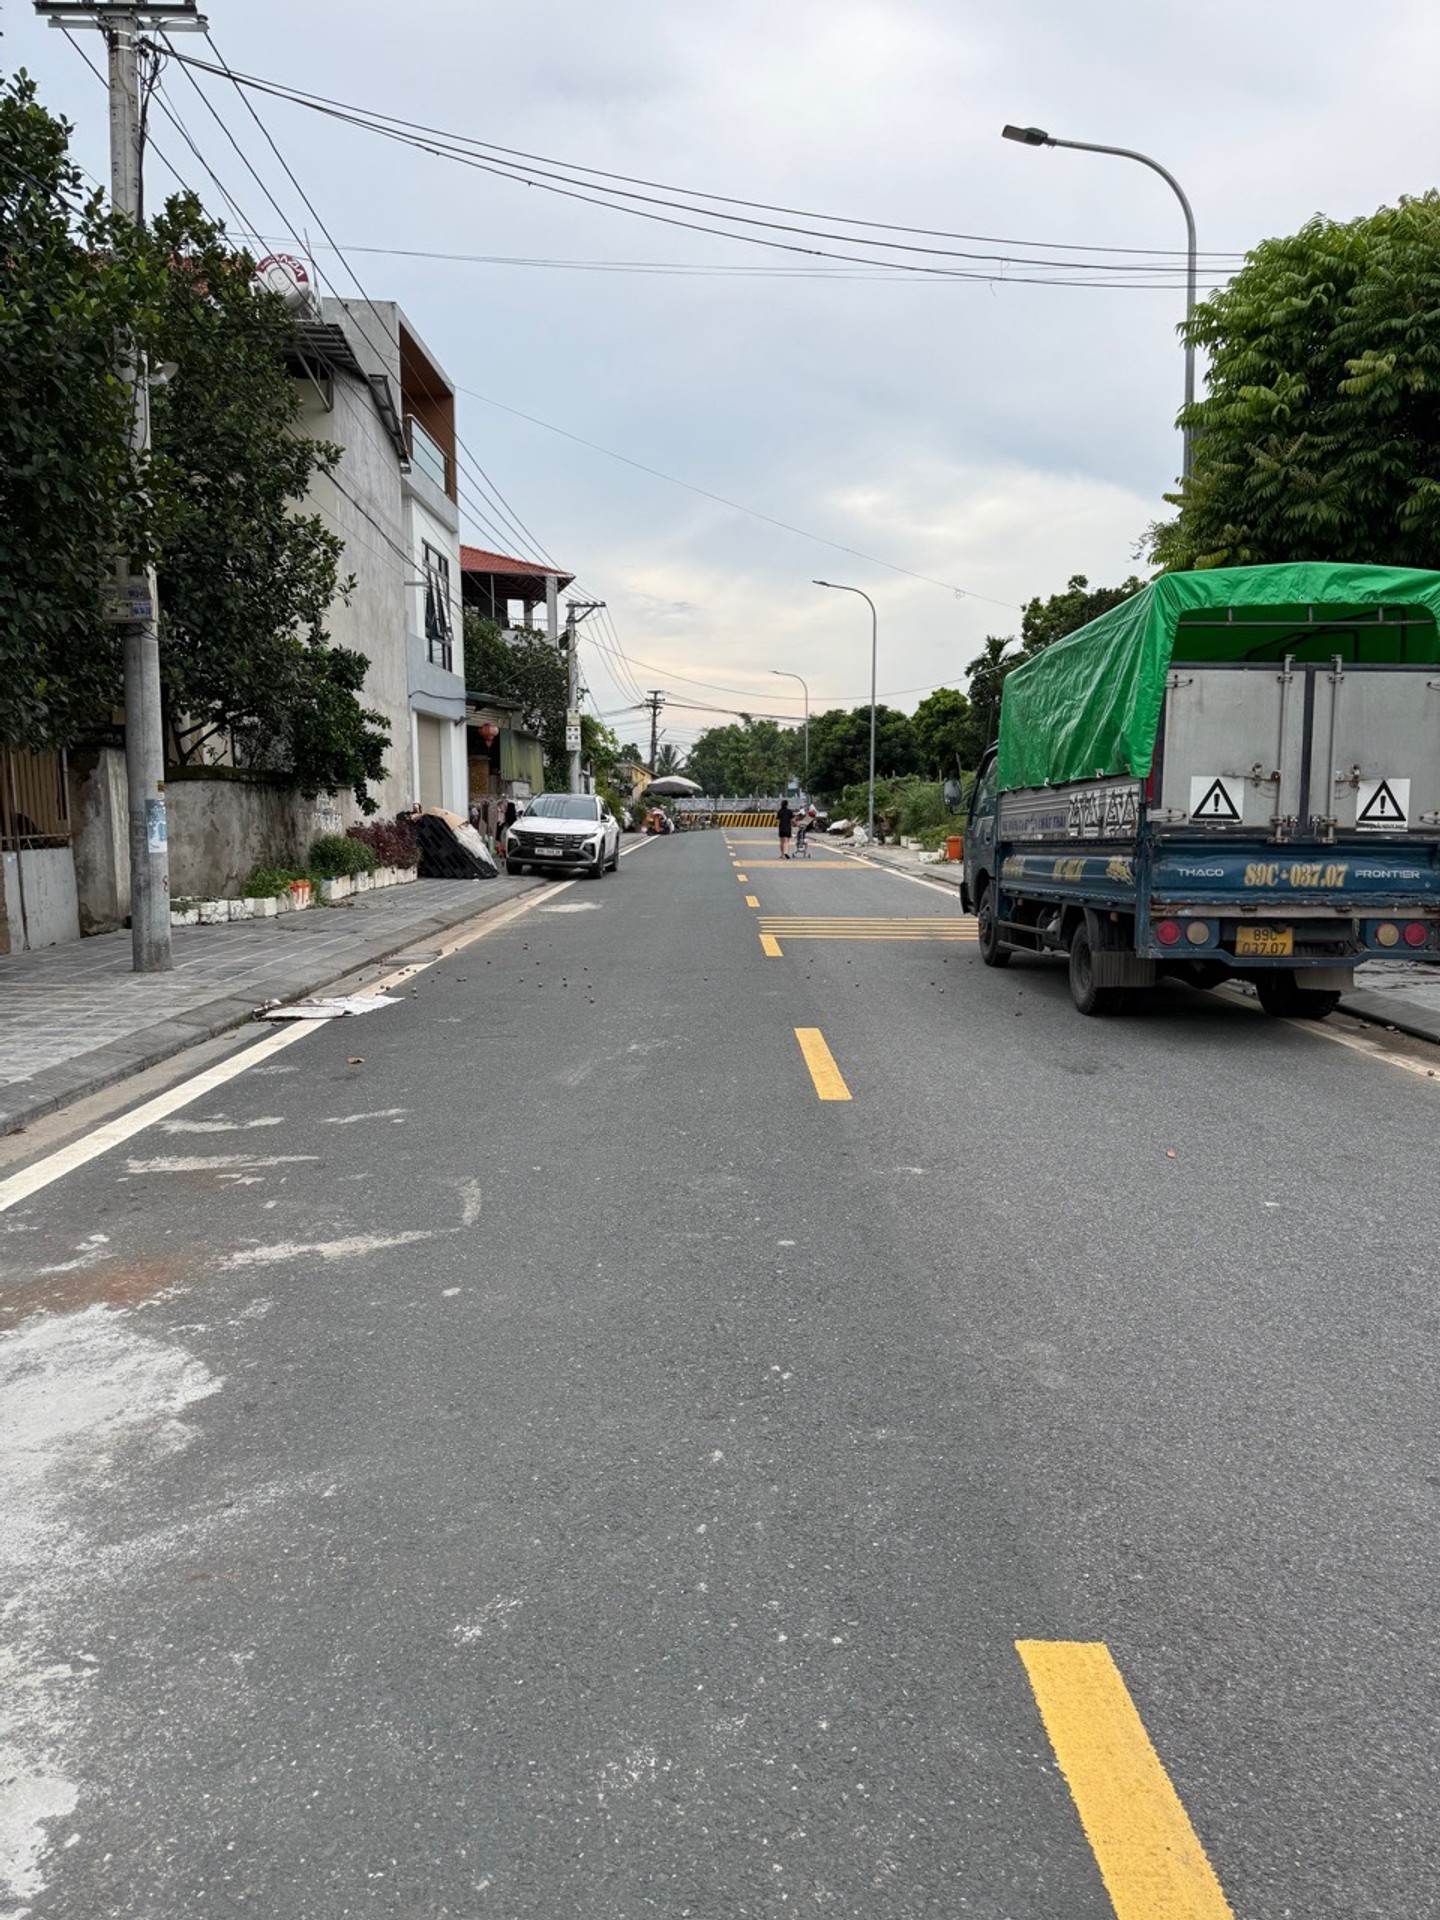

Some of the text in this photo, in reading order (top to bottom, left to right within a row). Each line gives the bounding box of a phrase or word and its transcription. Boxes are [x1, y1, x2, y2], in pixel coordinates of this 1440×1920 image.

[1177, 868, 1224, 877] THACO
[1354, 869, 1421, 879] FRONTIER
[1254, 928, 1277, 942] 89C
[1243, 942, 1287, 954] 037.07
